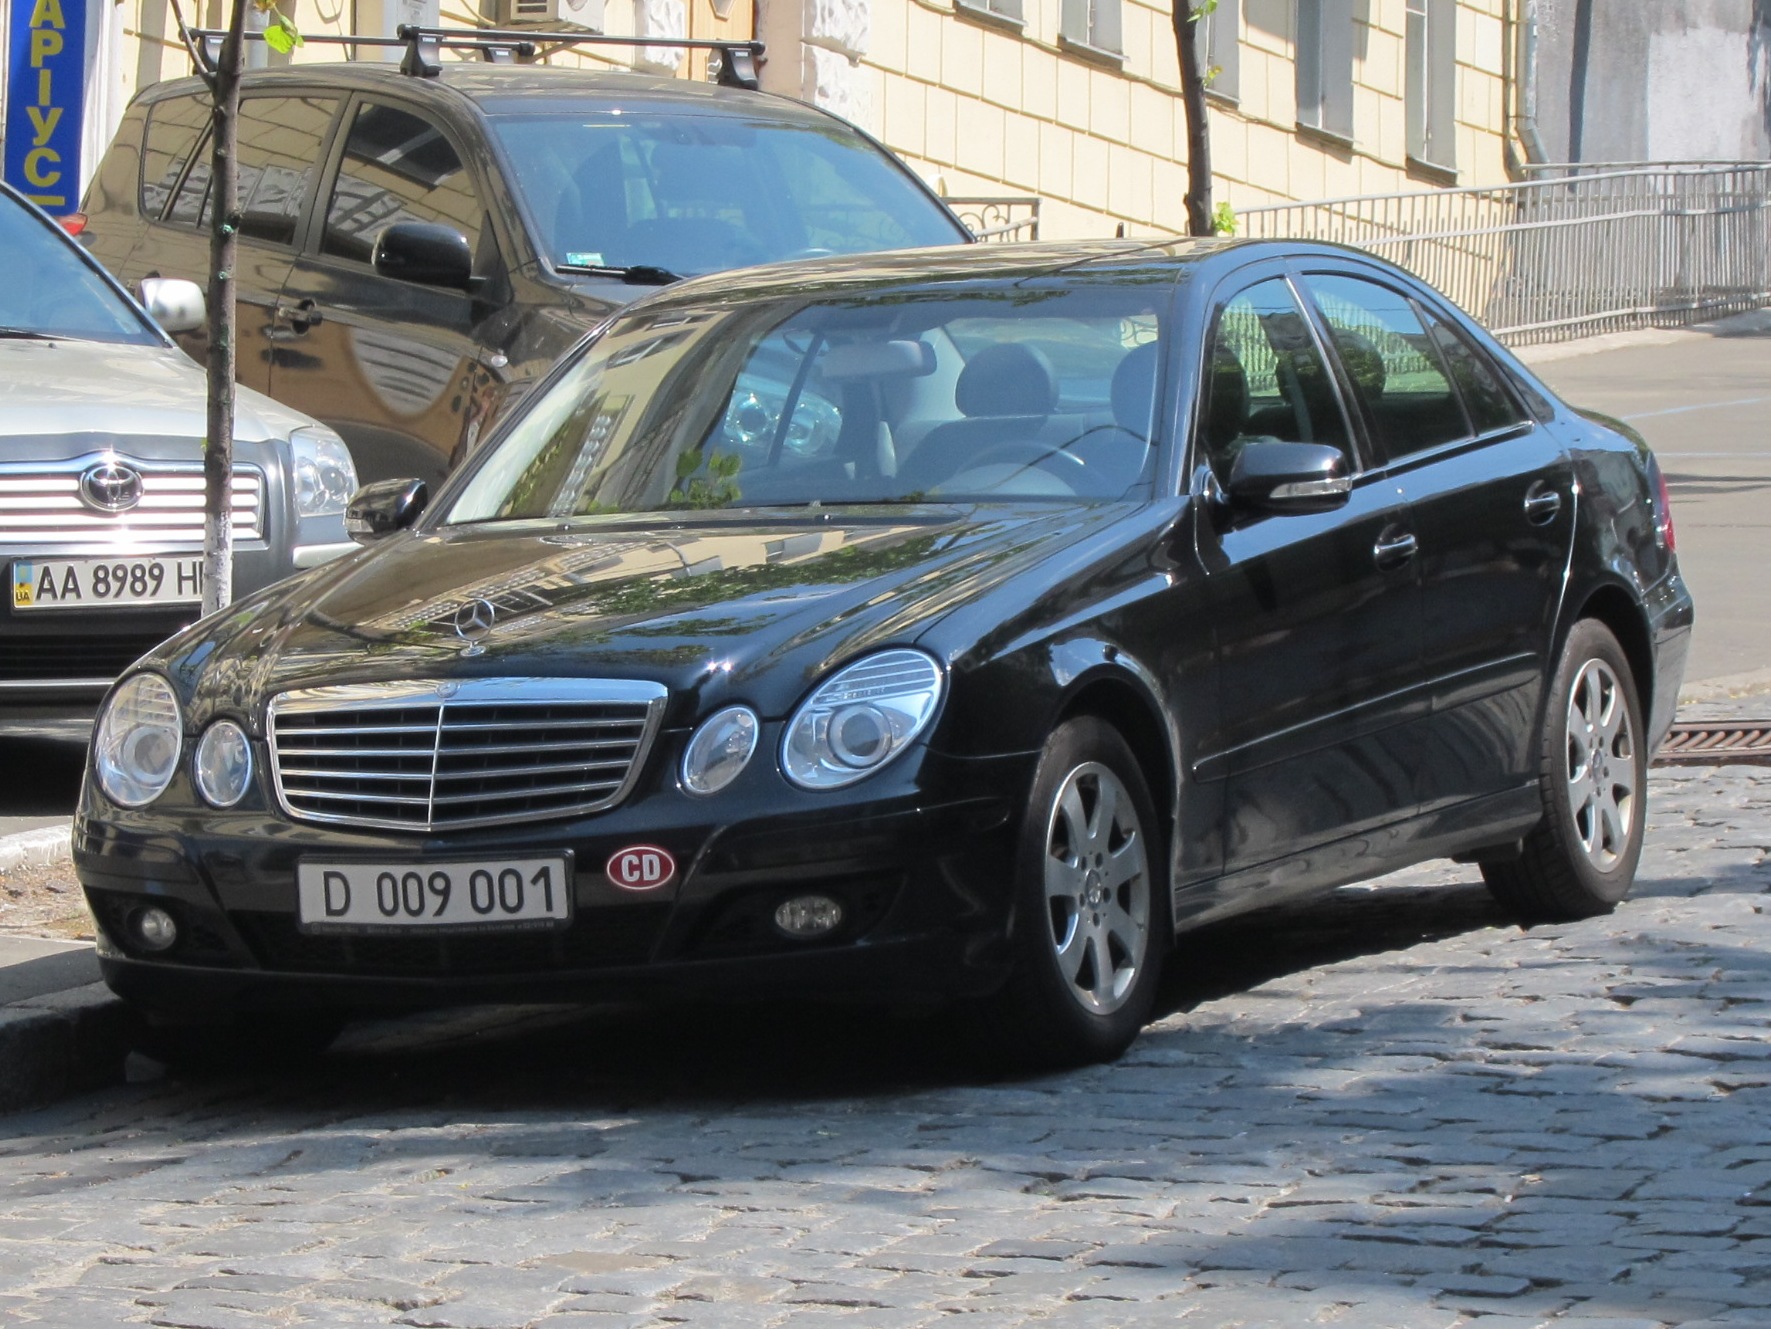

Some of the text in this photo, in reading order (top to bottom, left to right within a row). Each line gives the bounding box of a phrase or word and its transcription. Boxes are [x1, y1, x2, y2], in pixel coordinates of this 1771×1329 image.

[15, 590, 30, 601] UA
[36, 560, 204, 600] AA 8989 H
[620, 853, 661, 883] CD
[323, 866, 554, 918] D 009 001
